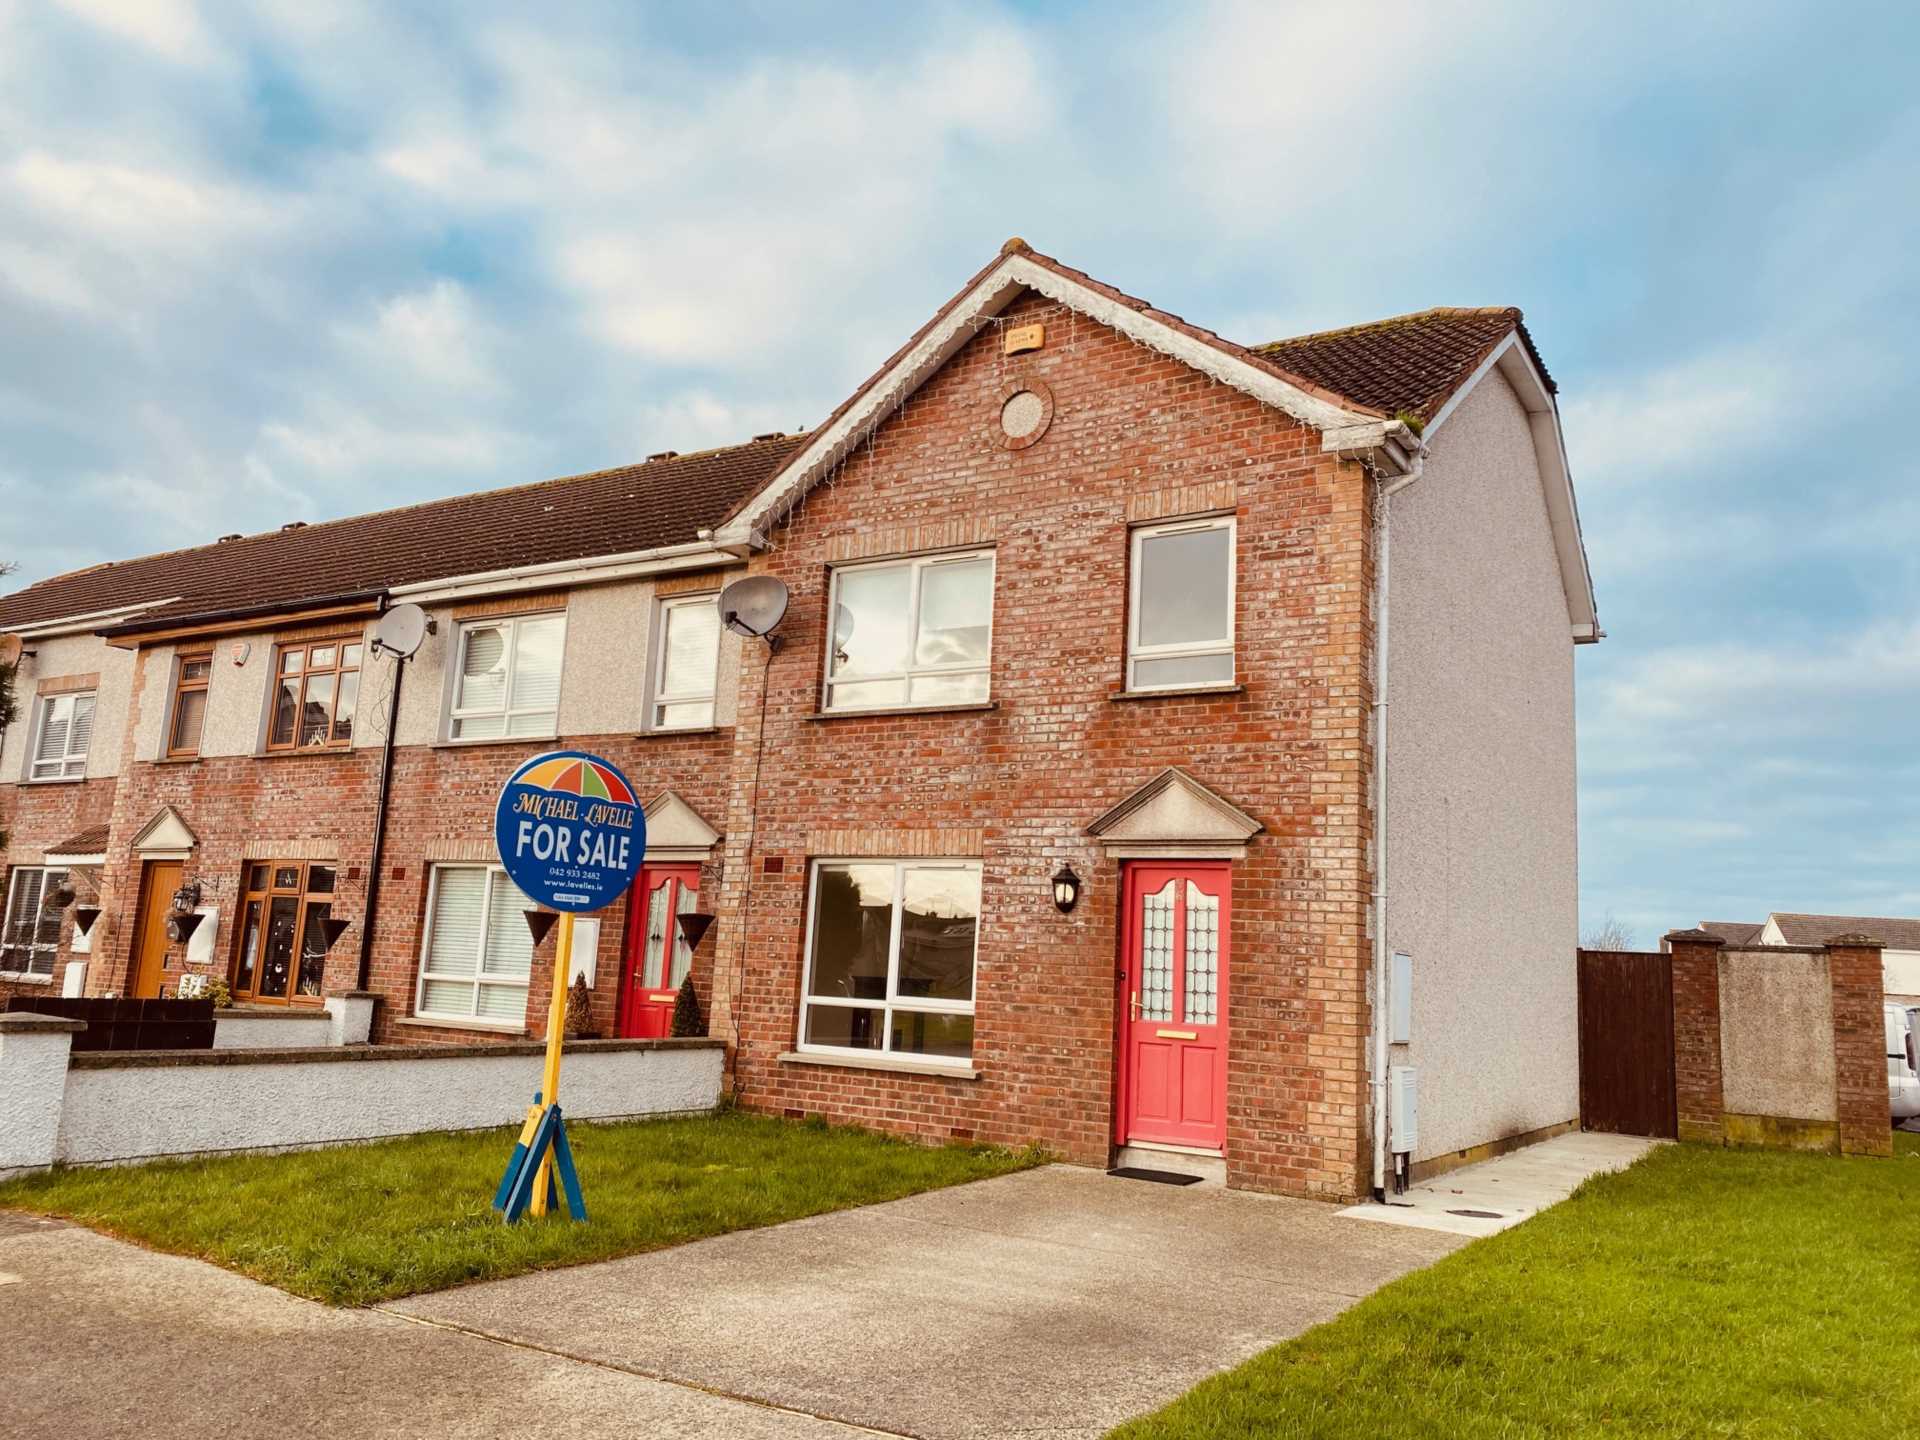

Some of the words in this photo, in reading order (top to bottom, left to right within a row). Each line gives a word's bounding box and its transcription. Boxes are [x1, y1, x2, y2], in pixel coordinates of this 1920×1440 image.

[513, 793, 578, 821] MICHAEL
[584, 803, 634, 829] LAVELLE
[516, 820, 571, 862] FOR
[577, 830, 630, 870] SALE
[550, 867, 564, 876] 042
[566, 869, 580, 878] 933
[544, 879, 603, 891] www.lavelles.ie
